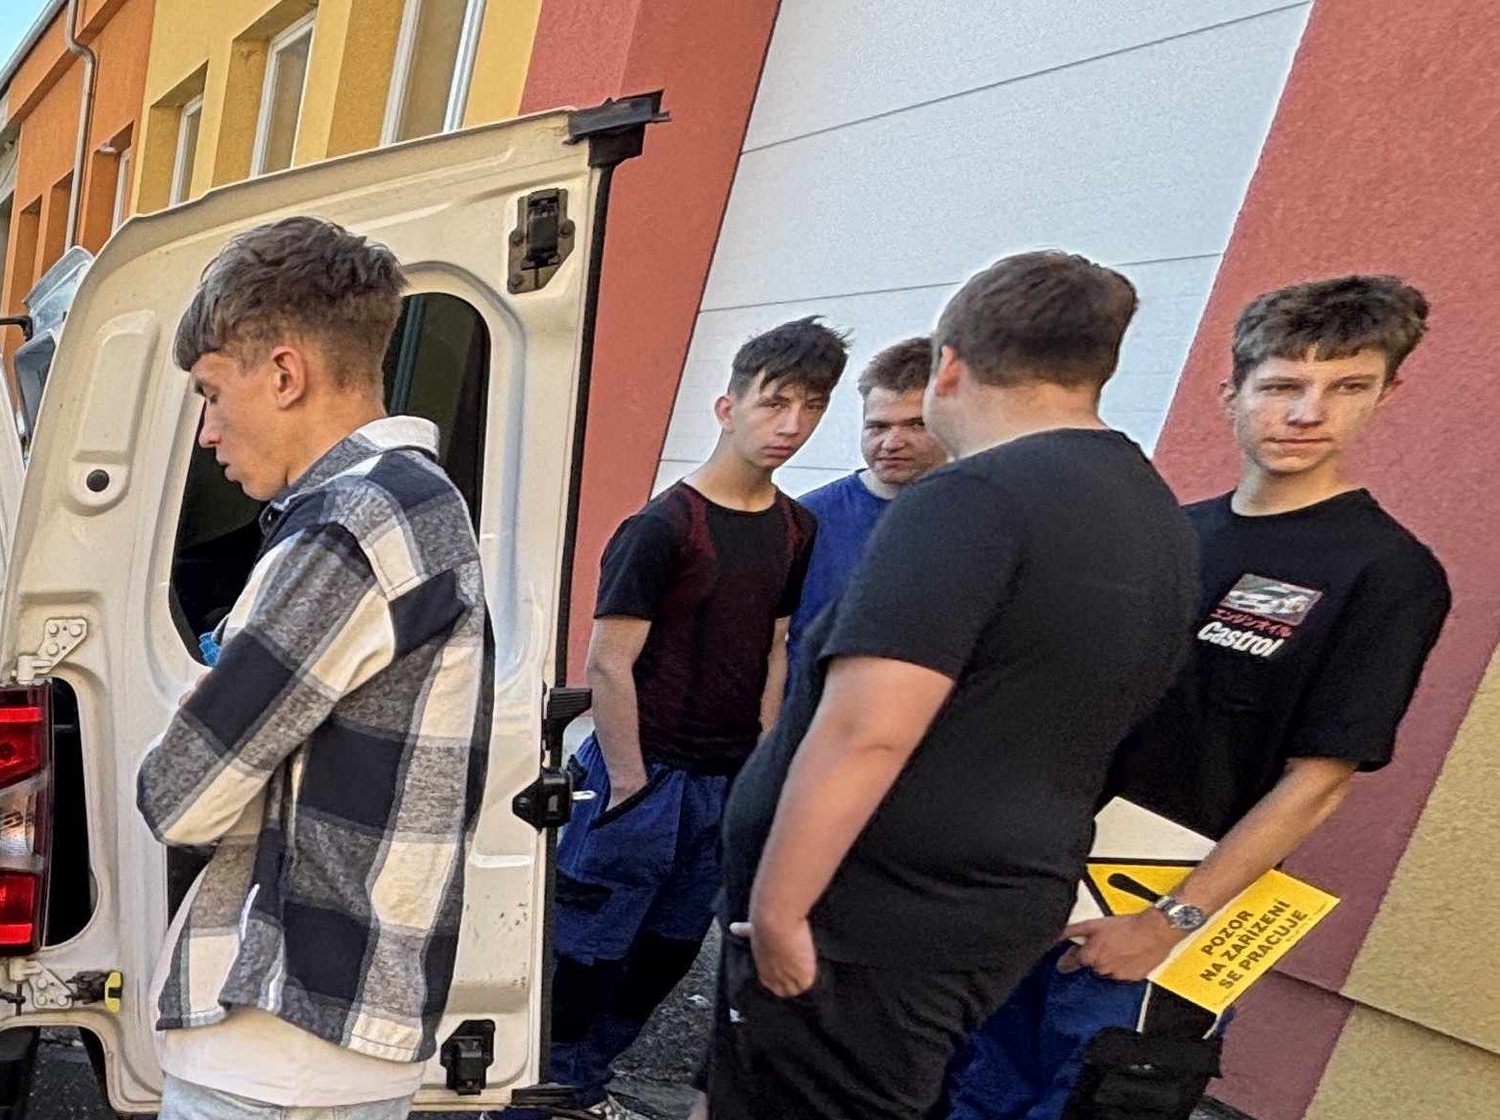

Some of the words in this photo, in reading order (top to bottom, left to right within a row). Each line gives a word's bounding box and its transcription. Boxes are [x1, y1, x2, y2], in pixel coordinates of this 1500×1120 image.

[1197, 621, 1285, 658] Castrol
[1200, 909, 1254, 956] POZOR
[1218, 969, 1244, 989] SE
[1238, 909, 1308, 971] PRACUJE
[1199, 962, 1227, 982] NA
